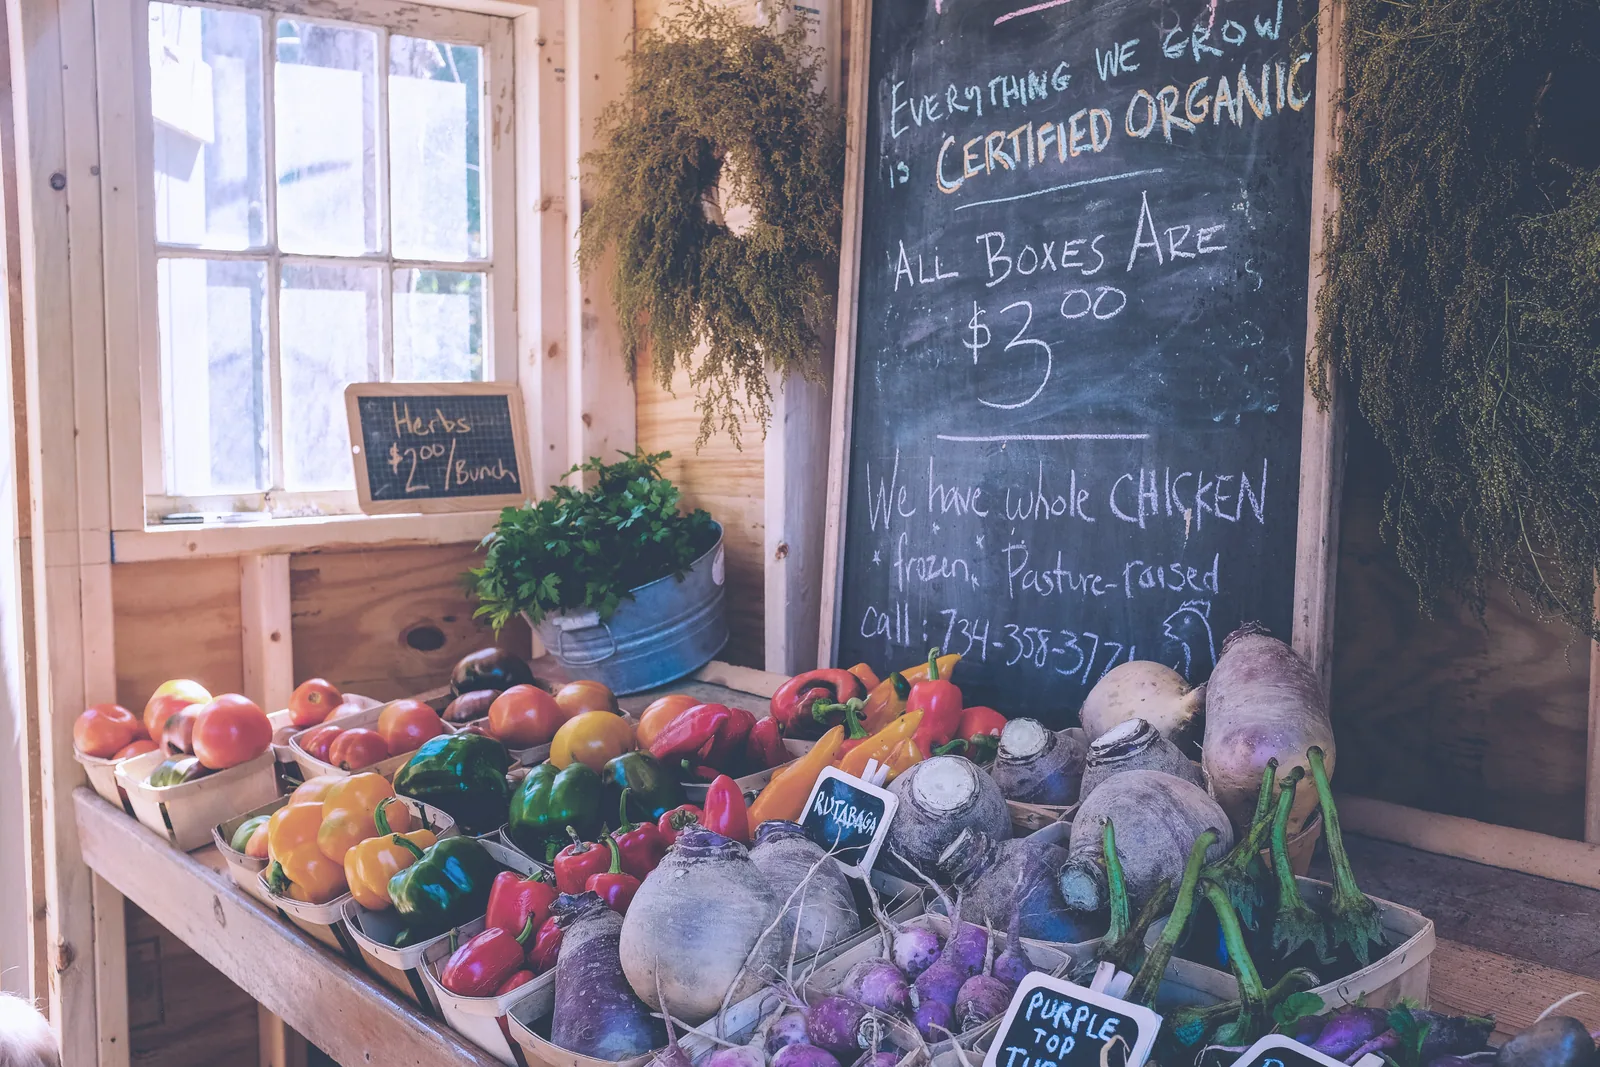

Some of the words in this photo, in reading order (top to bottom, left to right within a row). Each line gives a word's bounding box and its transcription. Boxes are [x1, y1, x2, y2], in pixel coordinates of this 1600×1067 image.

[1096, 38, 1140, 81] WE
[1163, 0, 1283, 62] GROW
[936, 108, 1112, 194] CERTIFIED
[1125, 52, 1312, 144] ORGANIC
[894, 240, 959, 292] ALL
[976, 231, 1105, 288] BOXES
[1126, 190, 1228, 272] ARE
[392, 401, 471, 438] Herbs
[866, 448, 916, 532] We
[929, 456, 989, 516] have
[1005, 461, 1096, 524] whole
[1110, 457, 1268, 532] CHICKEN
[813, 790, 877, 836] RUTABAGA
[1025, 991, 1121, 1042] PURPLE
[1033, 1027, 1076, 1060] TOP
